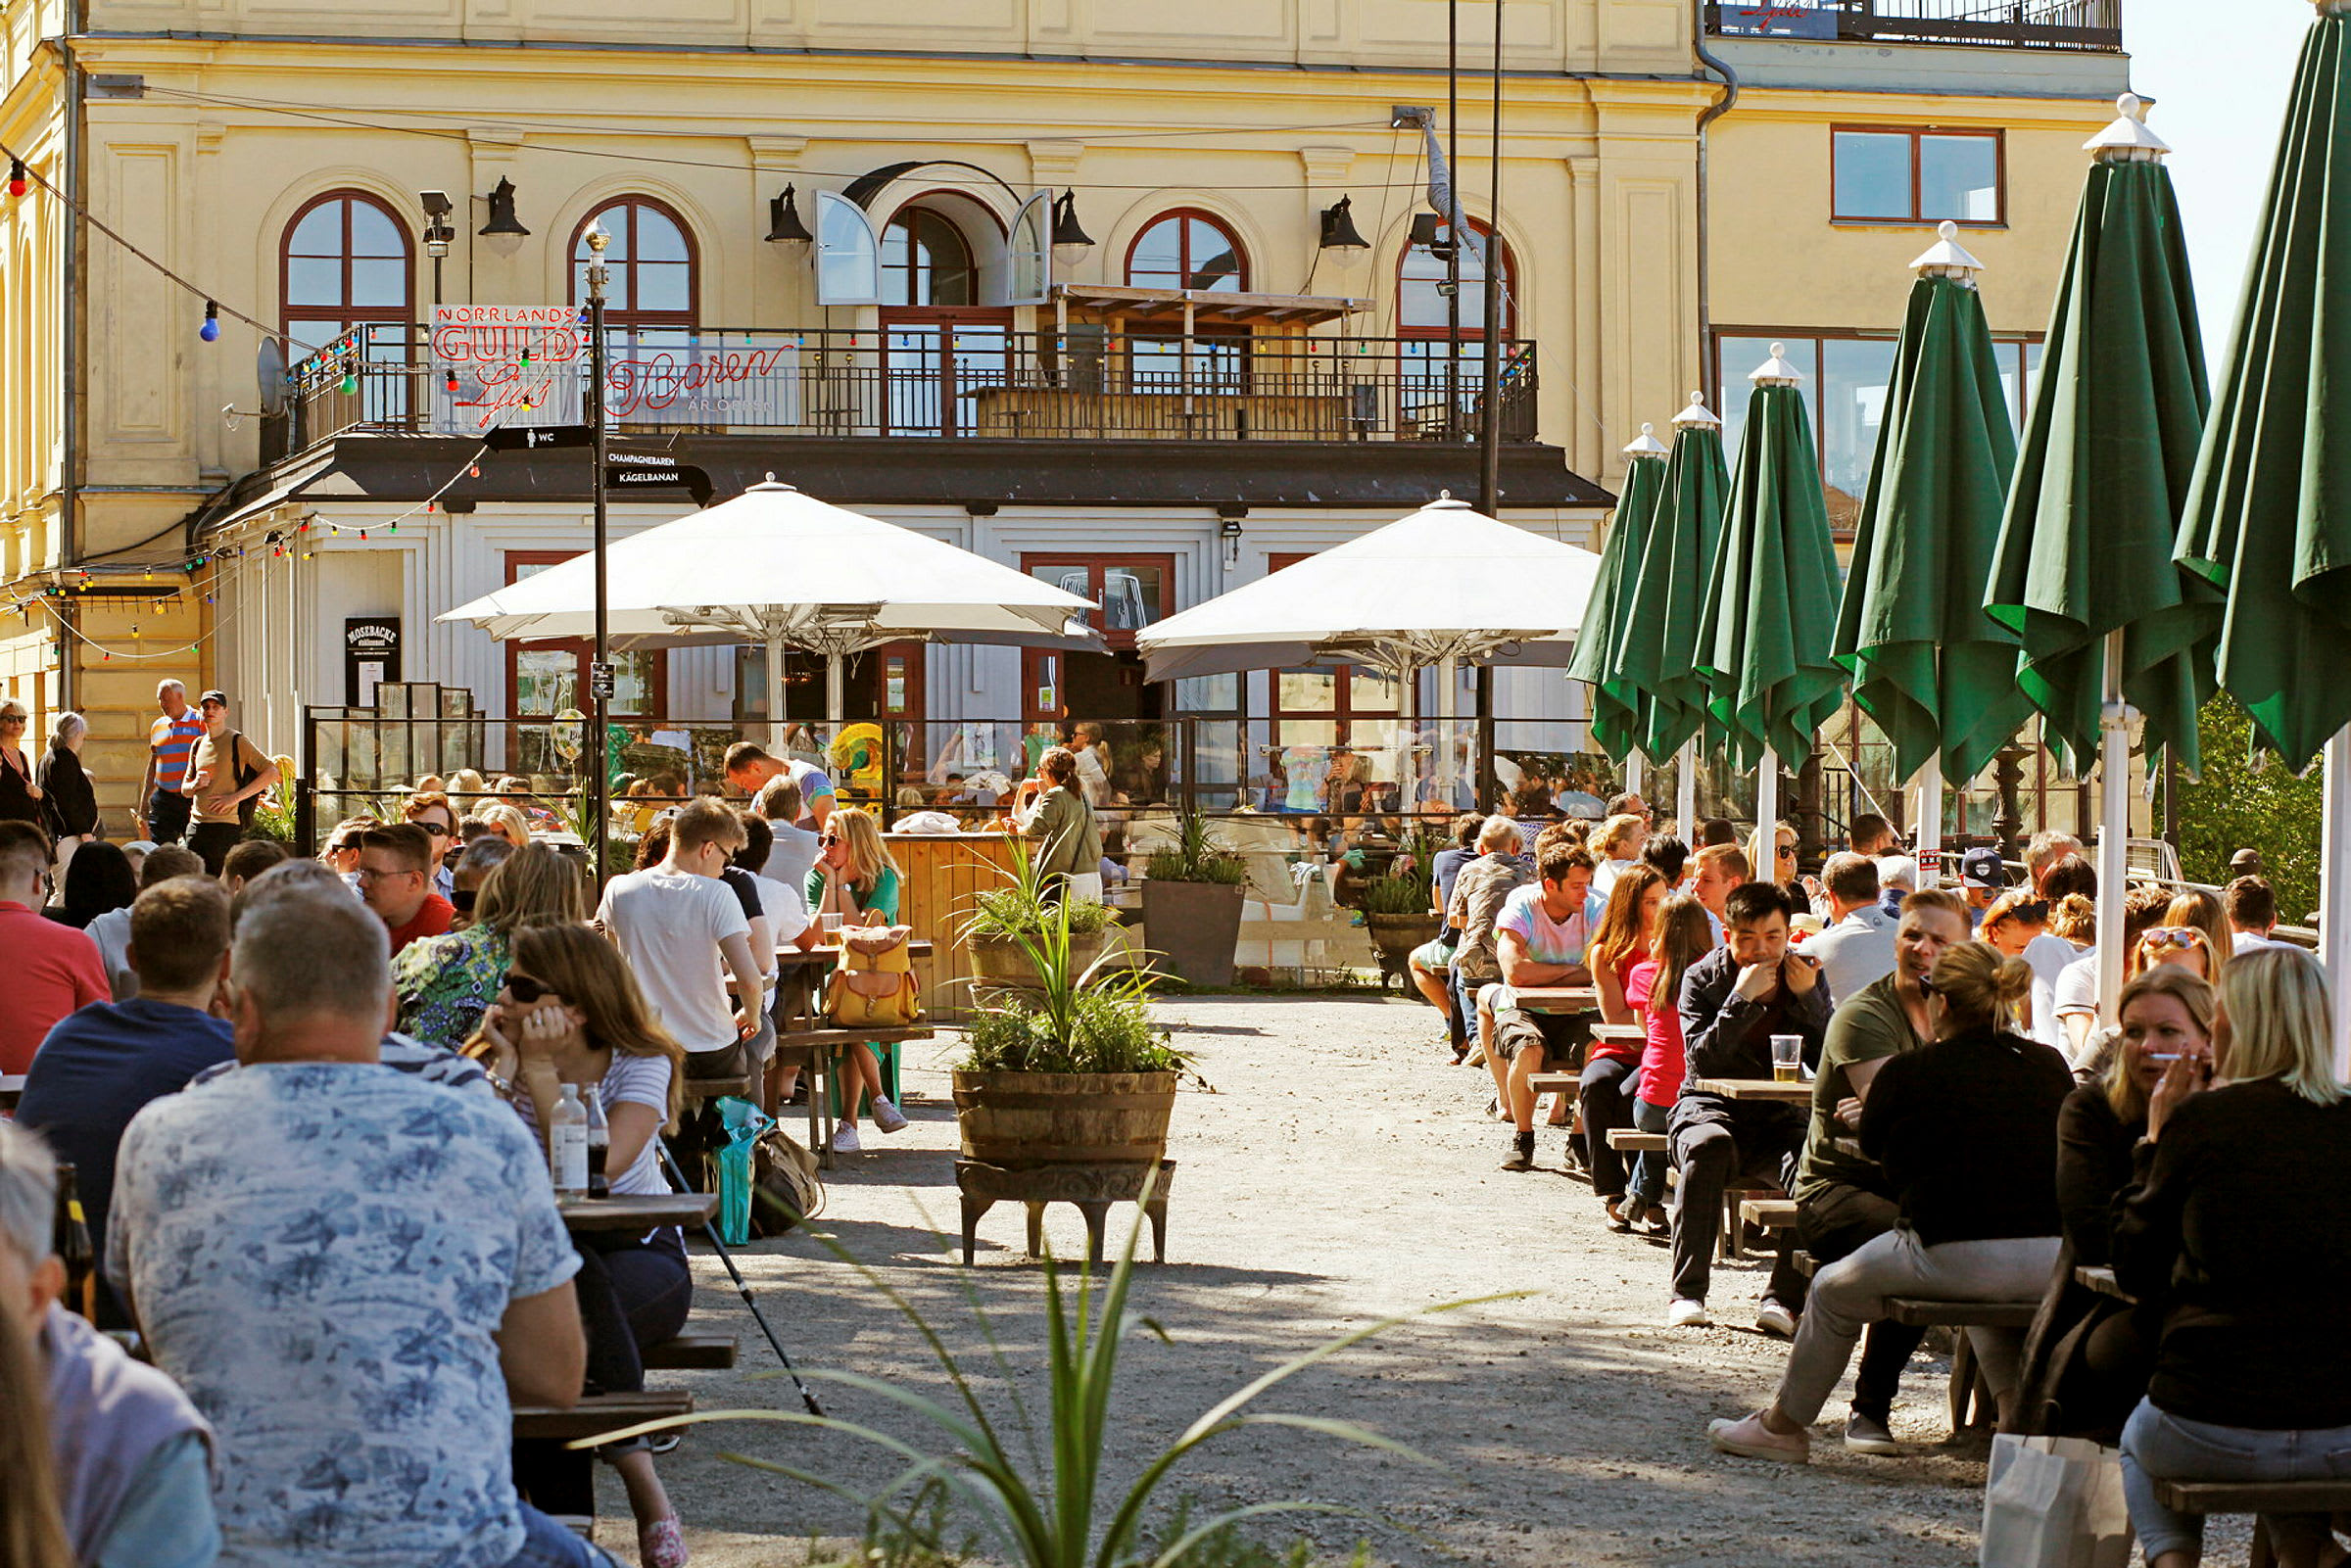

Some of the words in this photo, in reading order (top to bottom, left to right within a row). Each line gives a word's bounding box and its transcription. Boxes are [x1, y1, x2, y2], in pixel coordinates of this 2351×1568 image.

[438, 308, 575, 323] NORRLANDS
[602, 345, 794, 417] Baren
[538, 433, 554, 443] WC
[607, 452, 675, 466] CHAMPAGNEBAREN
[619, 471, 679, 483] KÄGELBANAN
